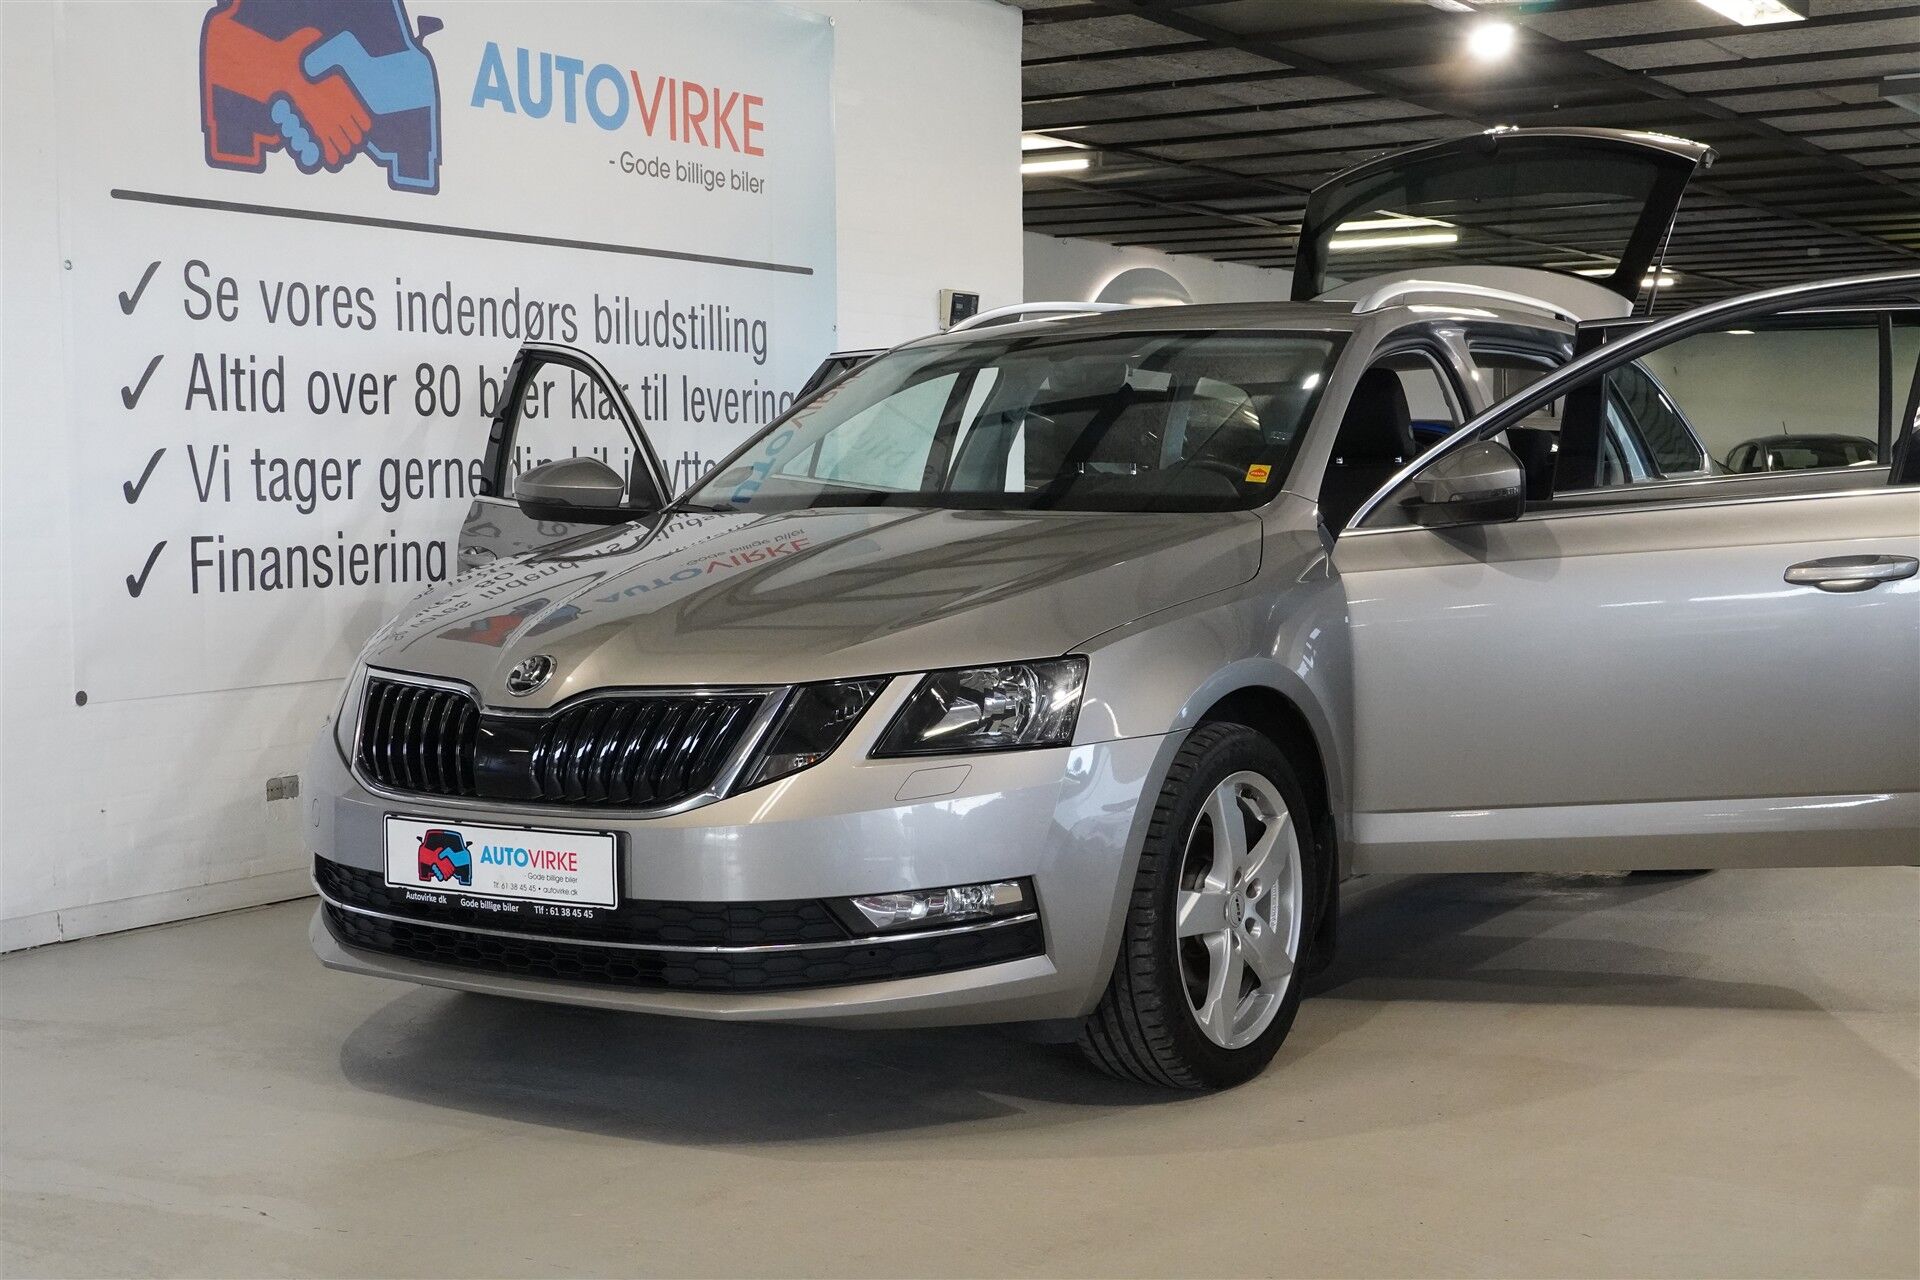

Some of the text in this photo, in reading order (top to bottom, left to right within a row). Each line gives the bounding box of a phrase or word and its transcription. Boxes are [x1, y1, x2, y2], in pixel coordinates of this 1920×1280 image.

[470, 41, 765, 157] AUTOVIRKE
[619, 150, 671, 179] Gode
[675, 159, 726, 192] billige
[730, 166, 765, 194] biler
[183, 259, 768, 366] Se vores indendørs biludstilling
[184, 352, 286, 414] Altid
[307, 369, 398, 415] over
[414, 362, 461, 418] 80
[641, 373, 668, 422] til
[187, 444, 232, 503] Vi
[250, 447, 362, 515] tager
[480, 845, 578, 872] AUTOVIRKE
[500, 882, 508, 890] 61
[510, 883, 518, 891] 38
[527, 872, 578, 884] Gode billige biler
[405, 891, 447, 904] Autovirke dk
[460, 898, 519, 913] Gode billige biler
[534, 905, 544, 915] Tlf
[550, 906, 560, 916] 61
[561, 907, 571, 917] 38
[572, 908, 582, 918] 45
[583, 909, 594, 919] 45
